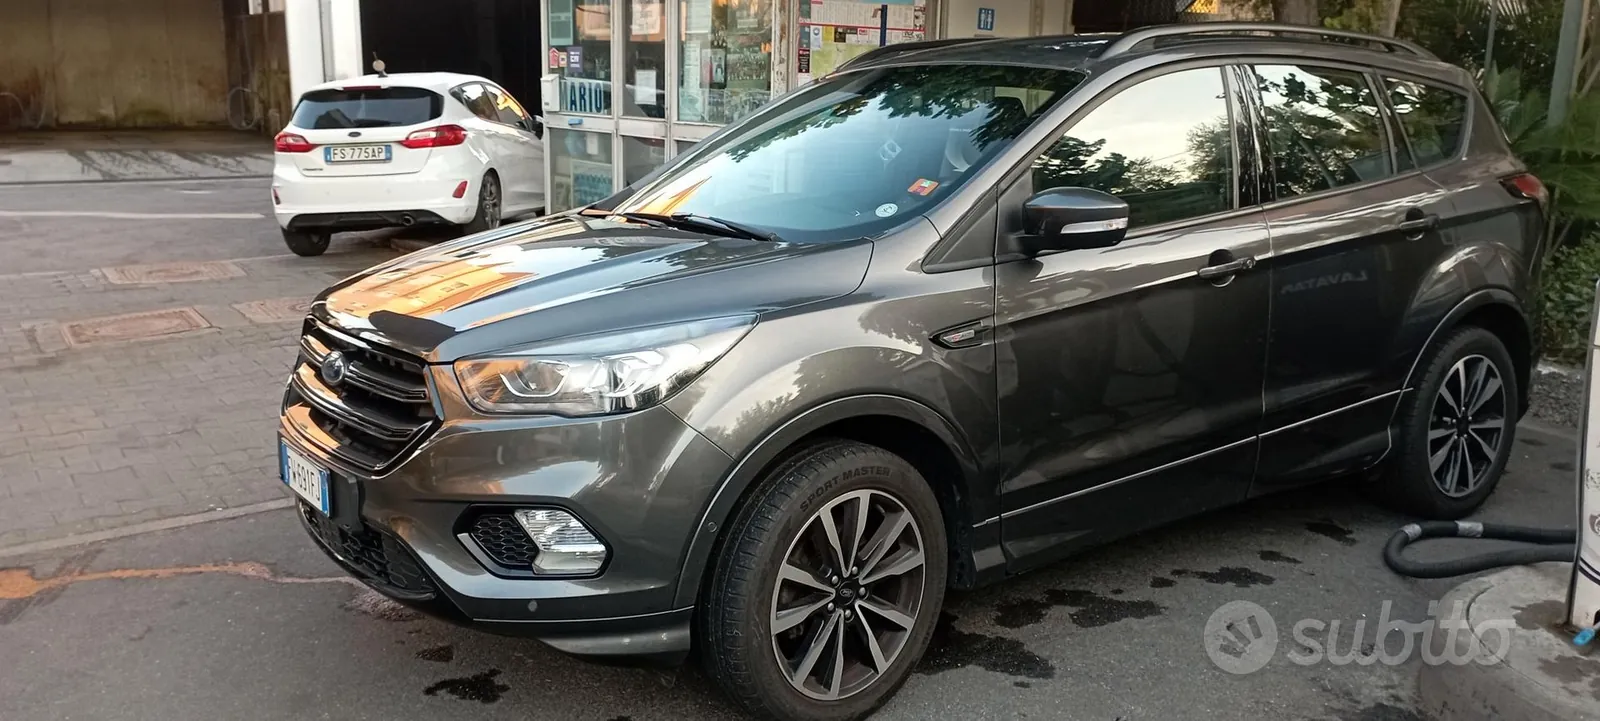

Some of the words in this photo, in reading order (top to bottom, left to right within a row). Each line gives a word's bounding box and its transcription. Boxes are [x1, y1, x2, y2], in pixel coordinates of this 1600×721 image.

[560, 80, 603, 113] MARIO
[799, 475, 840, 512] SPORT
[842, 466, 890, 480] MASTER
